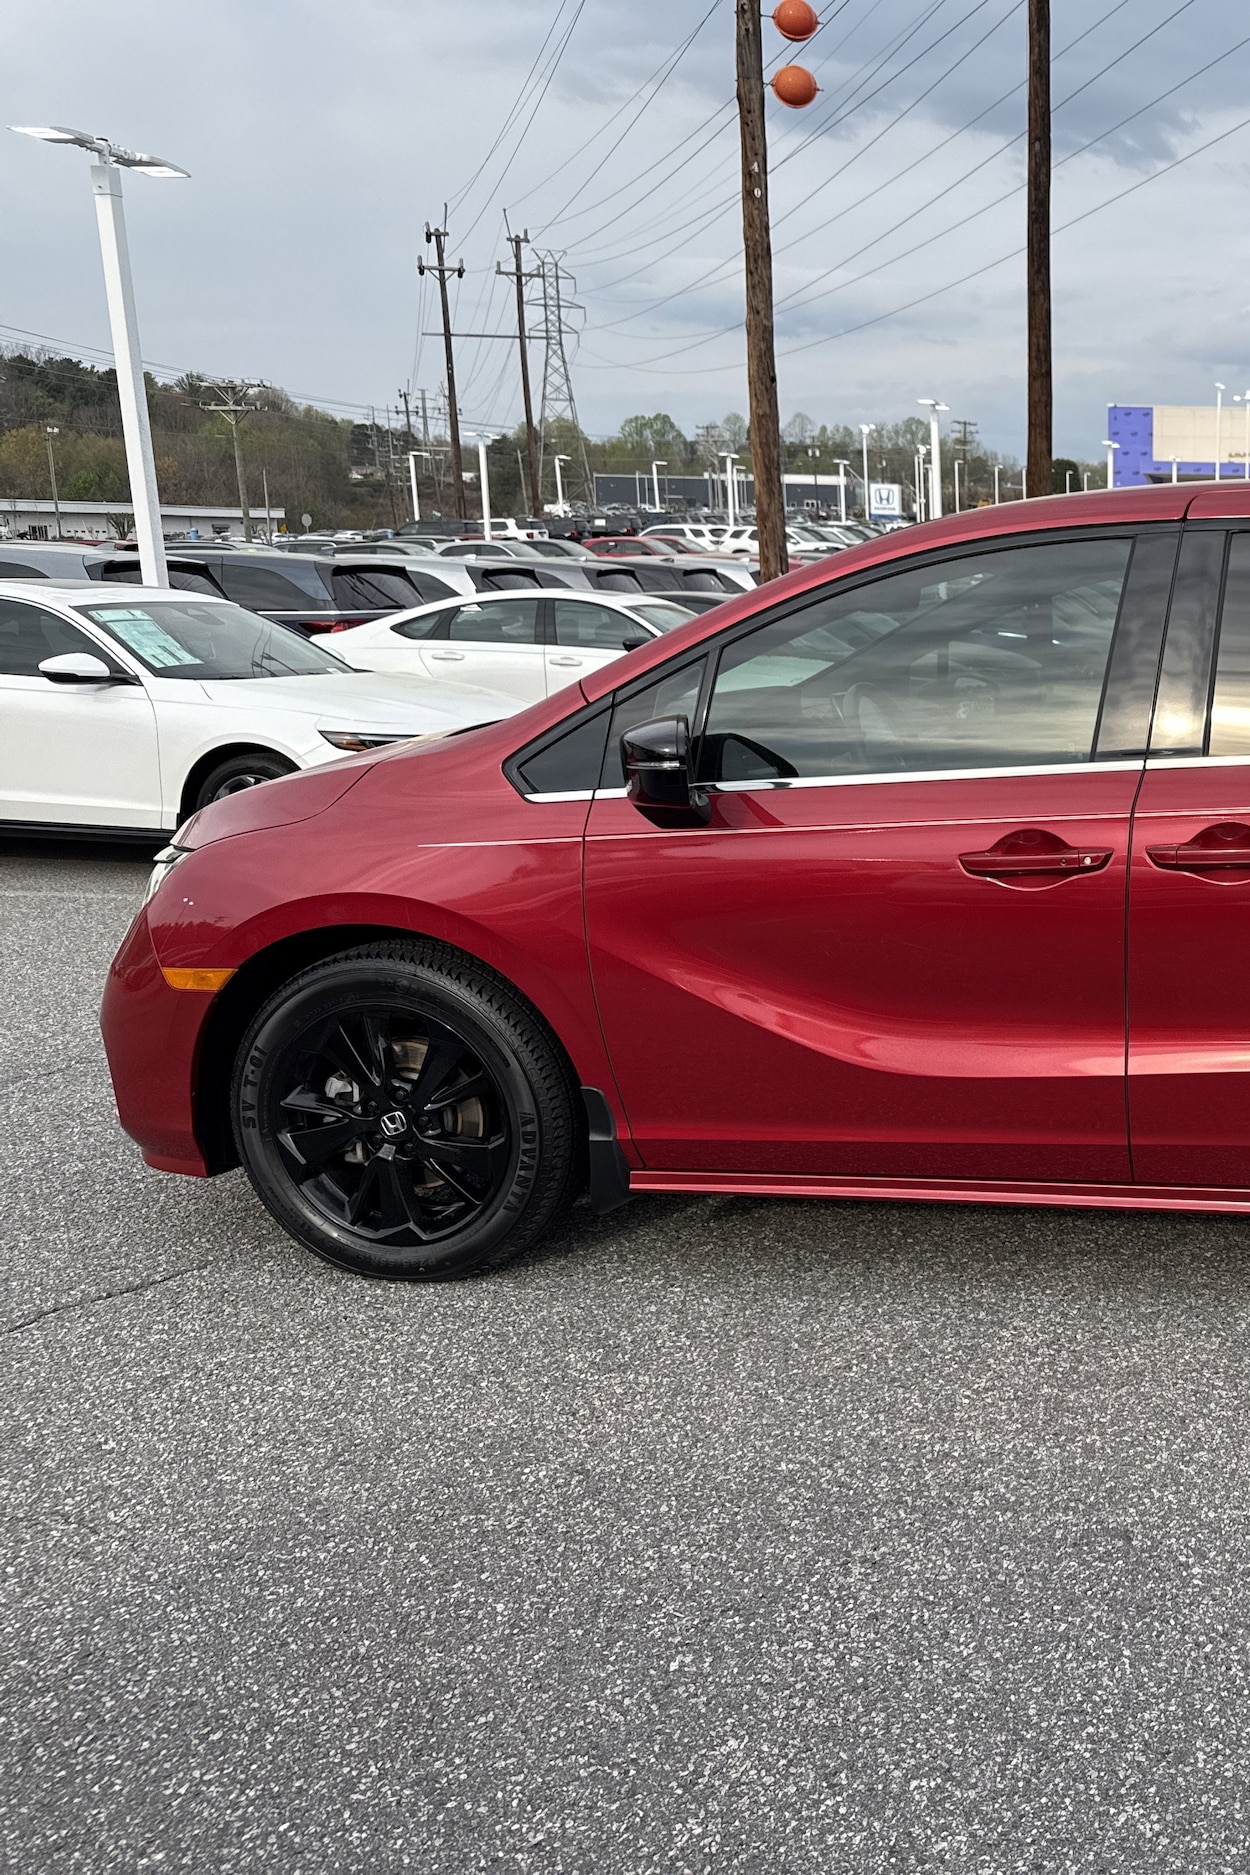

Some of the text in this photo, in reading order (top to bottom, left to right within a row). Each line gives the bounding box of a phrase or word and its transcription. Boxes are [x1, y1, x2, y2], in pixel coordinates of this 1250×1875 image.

[241, 1045, 268, 1129] SV T-01
[503, 1111, 537, 1213] ADVANTA
